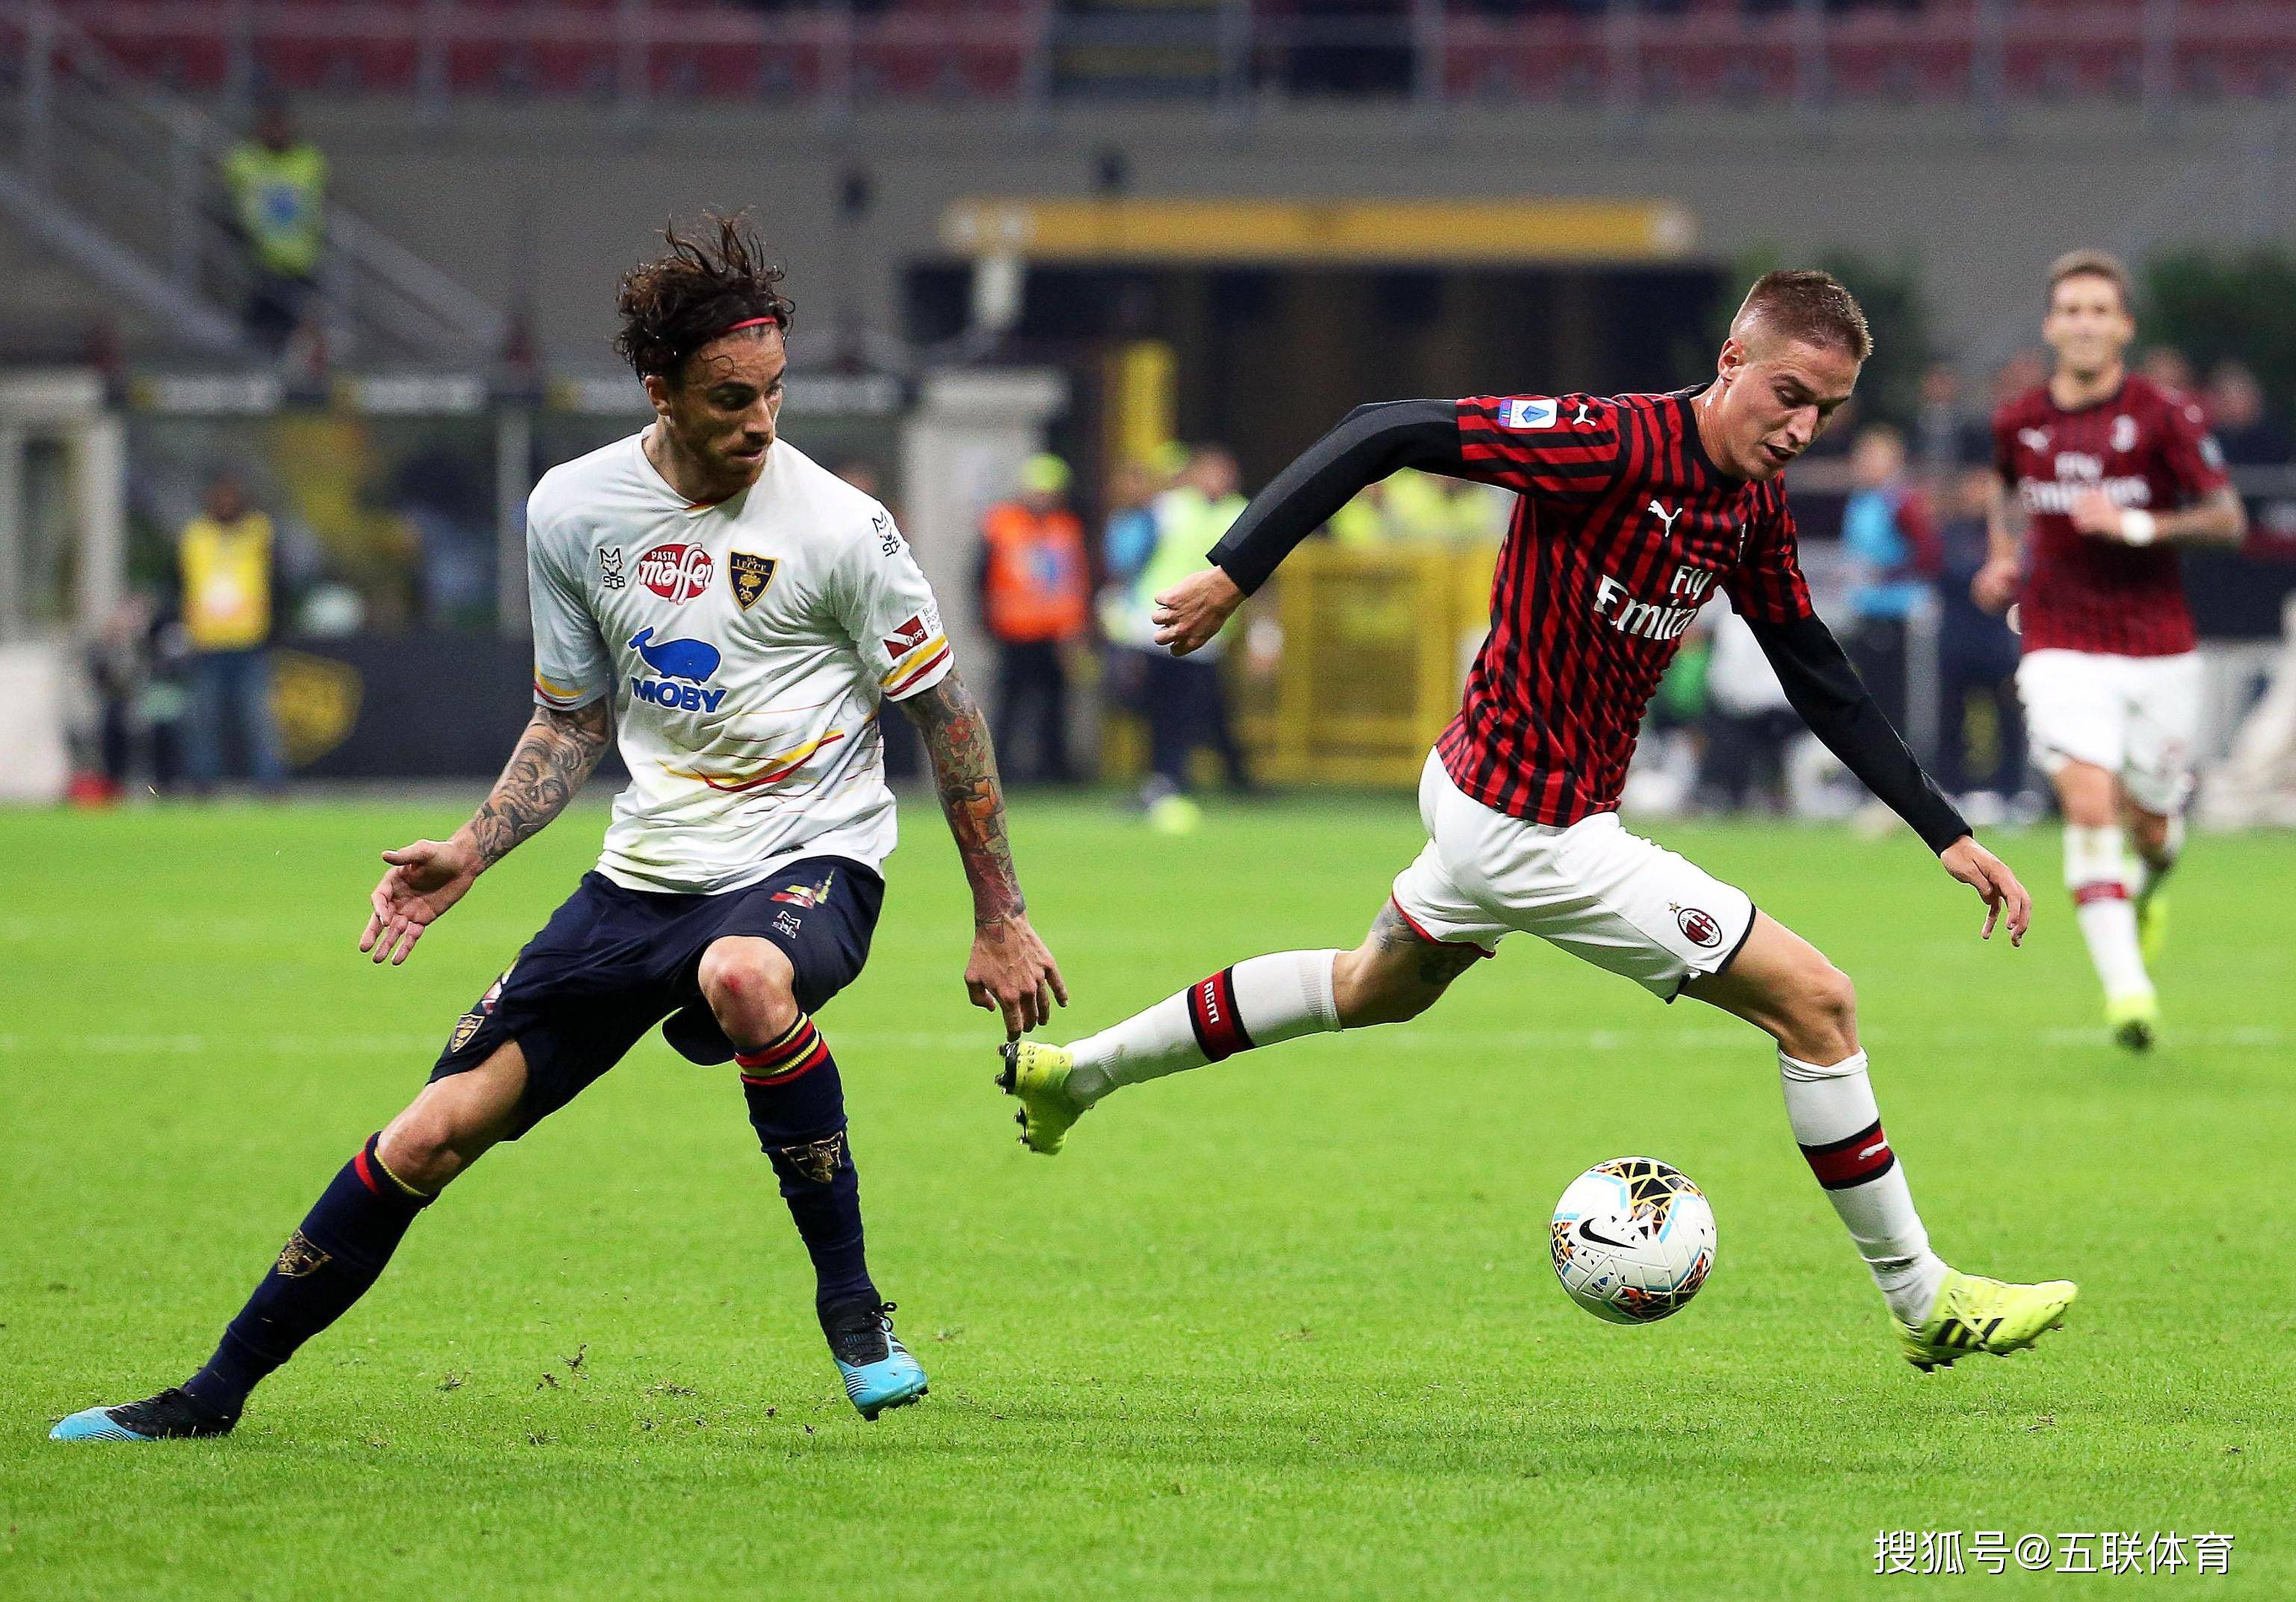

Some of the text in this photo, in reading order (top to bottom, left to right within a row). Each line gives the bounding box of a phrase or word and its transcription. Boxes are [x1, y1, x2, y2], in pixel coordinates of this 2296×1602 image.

[651, 551, 677, 561] PASTA
[736, 559, 766, 572] LECCE
[1670, 565, 1713, 601] Fly
[631, 676, 727, 713] MOBY
